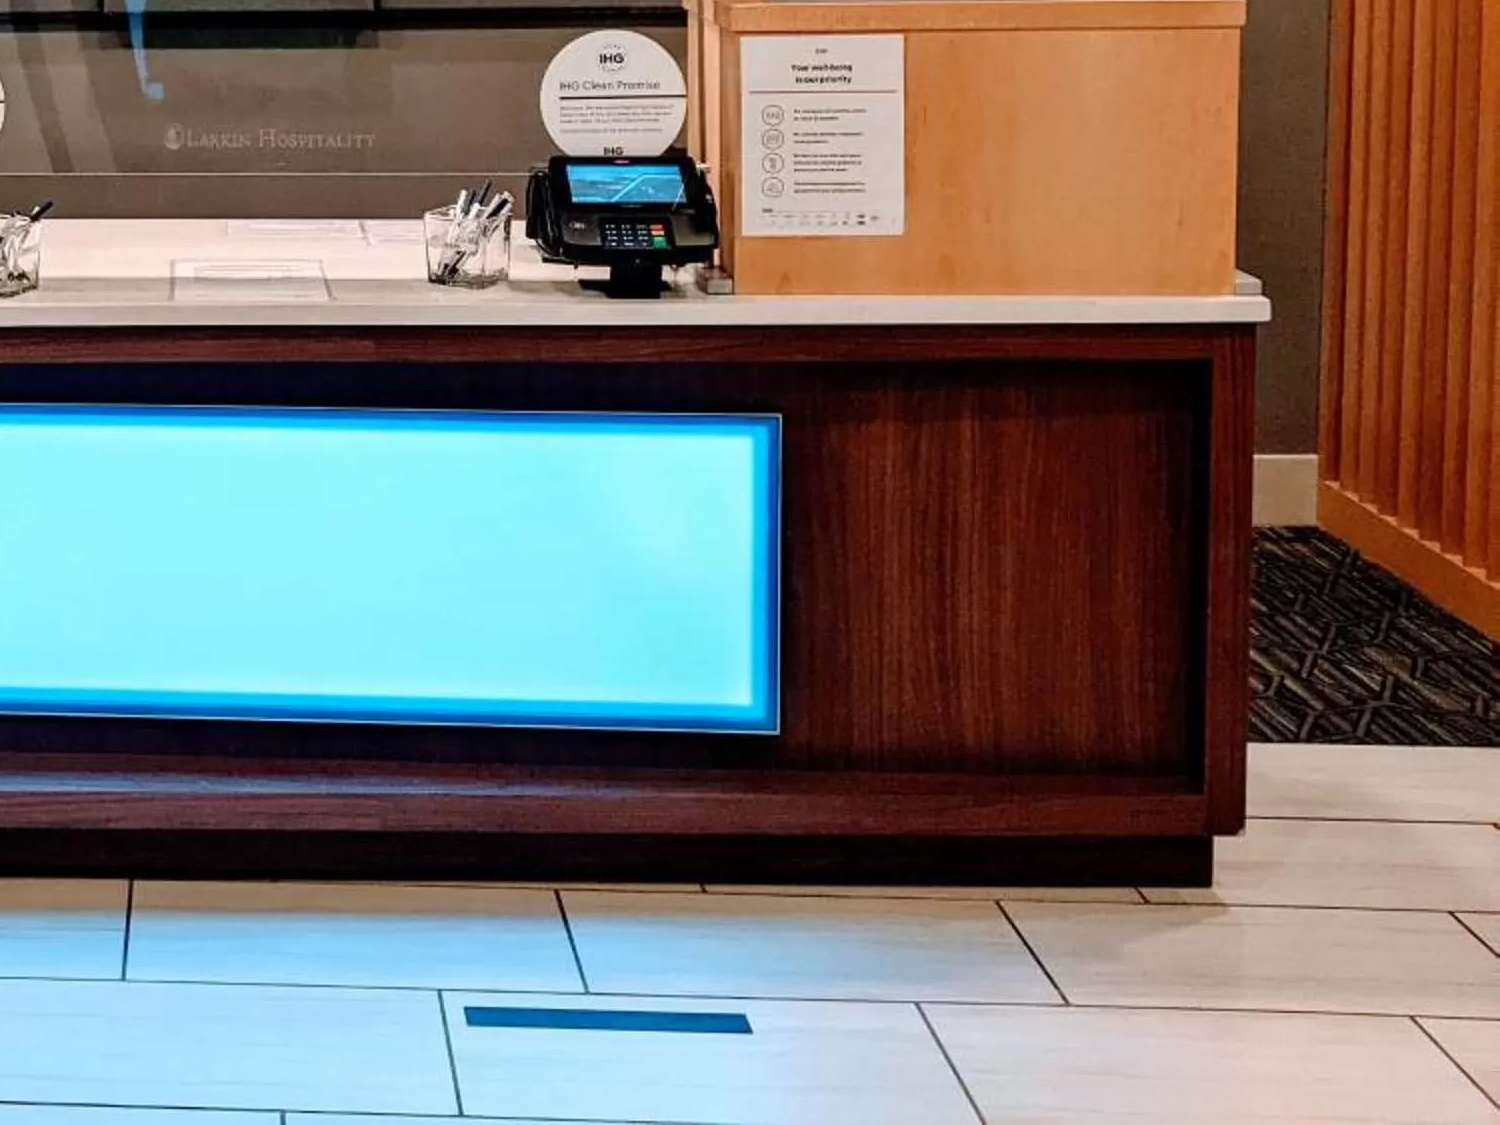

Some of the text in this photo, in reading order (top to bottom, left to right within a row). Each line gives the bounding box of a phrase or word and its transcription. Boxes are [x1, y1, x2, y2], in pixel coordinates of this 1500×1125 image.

[599, 52, 625, 64] IHG
[559, 79, 661, 92] IHG Clean Promise
[603, 146, 624, 156] IHG
